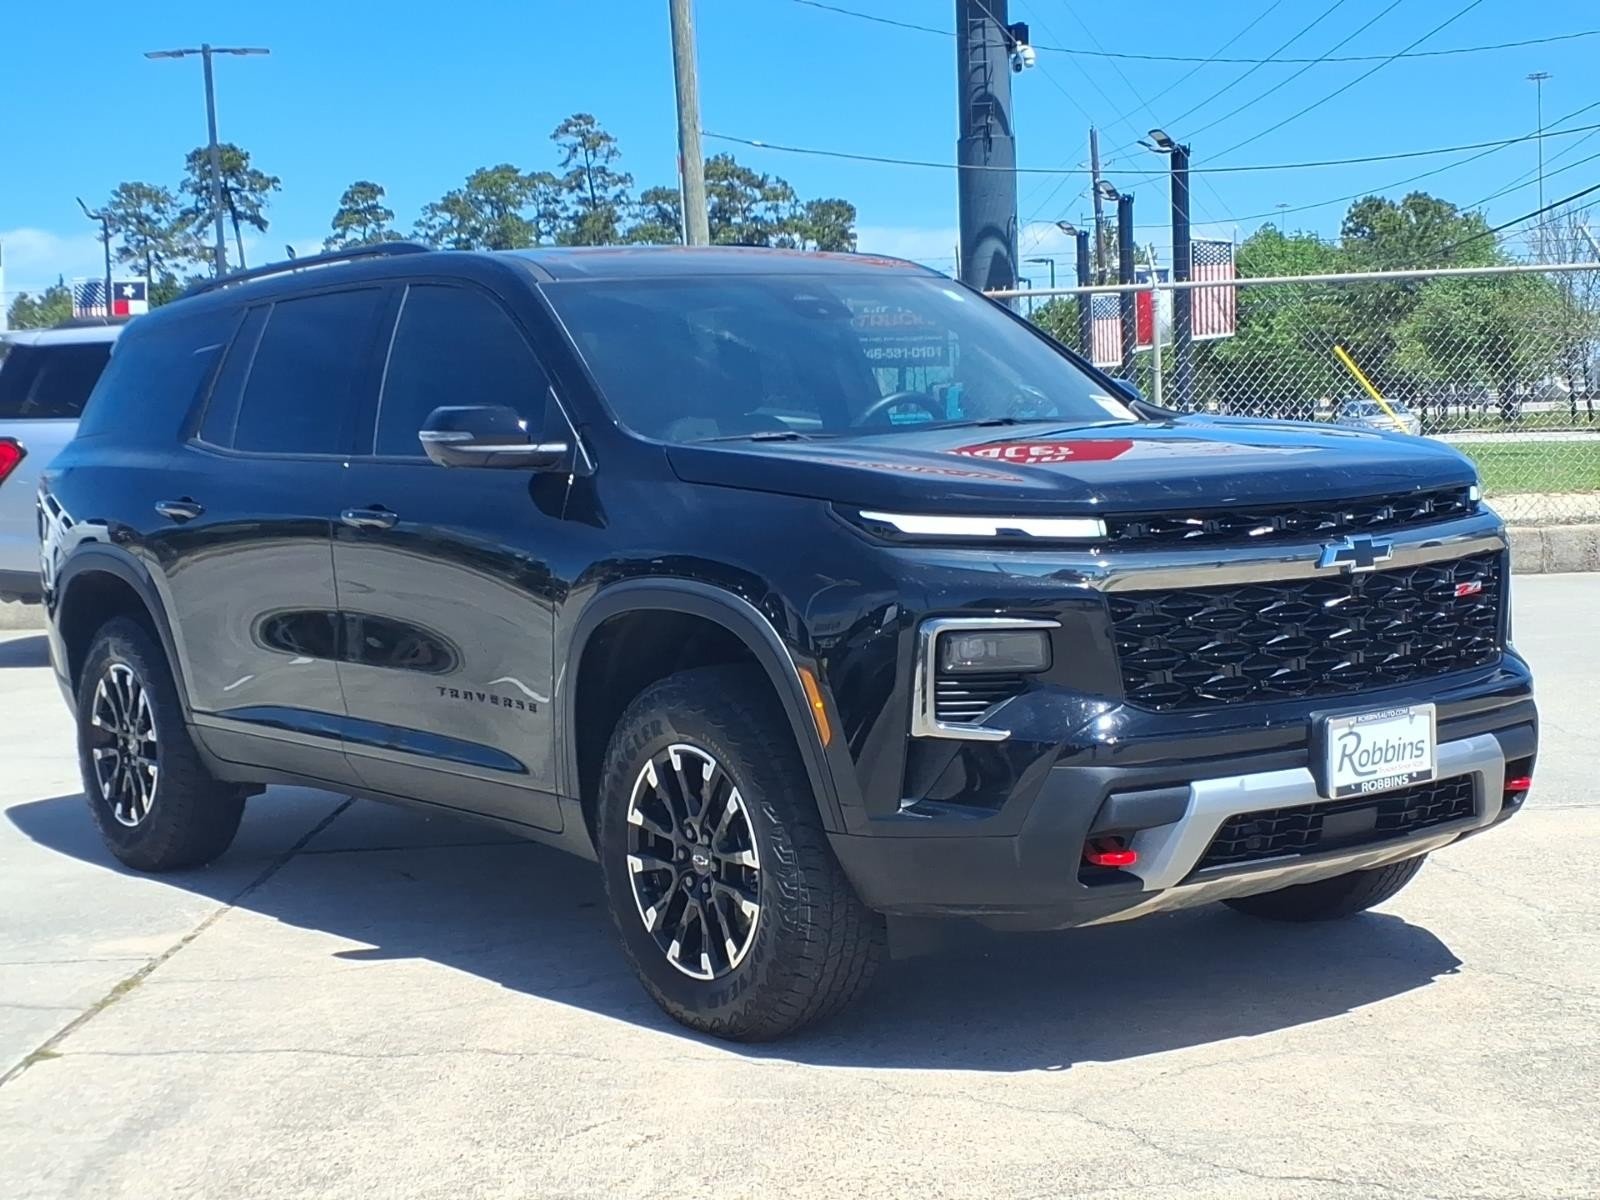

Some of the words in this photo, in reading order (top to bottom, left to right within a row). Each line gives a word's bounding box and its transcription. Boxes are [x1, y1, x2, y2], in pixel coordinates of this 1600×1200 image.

[435, 685, 538, 713] TRAVERSE
[1337, 731, 1425, 777] Robbins
[1361, 774, 1409, 793] ROBBINS
